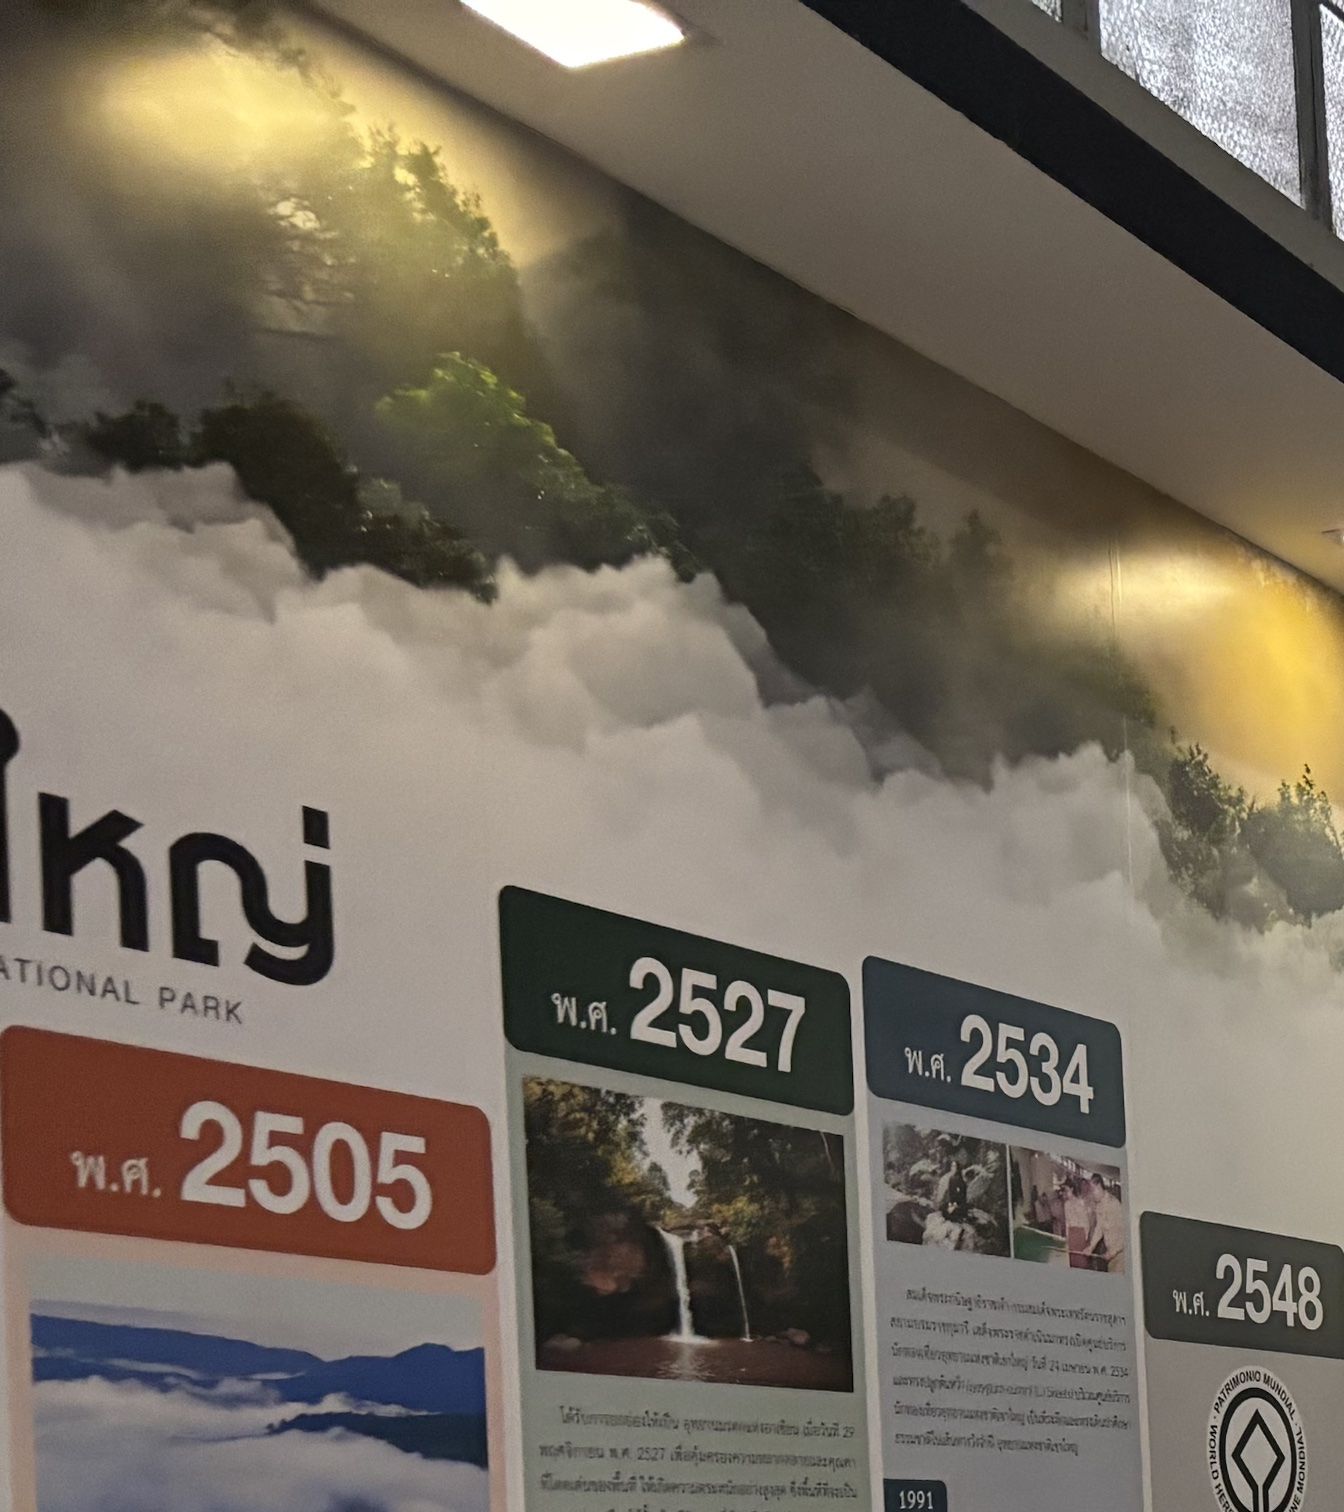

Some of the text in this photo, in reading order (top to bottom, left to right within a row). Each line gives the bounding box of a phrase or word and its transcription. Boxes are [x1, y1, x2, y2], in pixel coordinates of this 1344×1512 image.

[158, 986, 243, 1024] PARK
[550, 956, 806, 1073] พ.ศ. 2527
[903, 1014, 1094, 1114] พ.ศ. 2534
[69, 1100, 433, 1230] พ.ศ. 2505
[1172, 1253, 1324, 1330] พ.ศ. 2548
[1213, 1370, 1295, 1421] PATRIMONIO MUNDIAL
[1208, 1425, 1219, 1480] WORLD
[1295, 1426, 1306, 1494] MONDIAL
[899, 1489, 934, 1510] 1991
